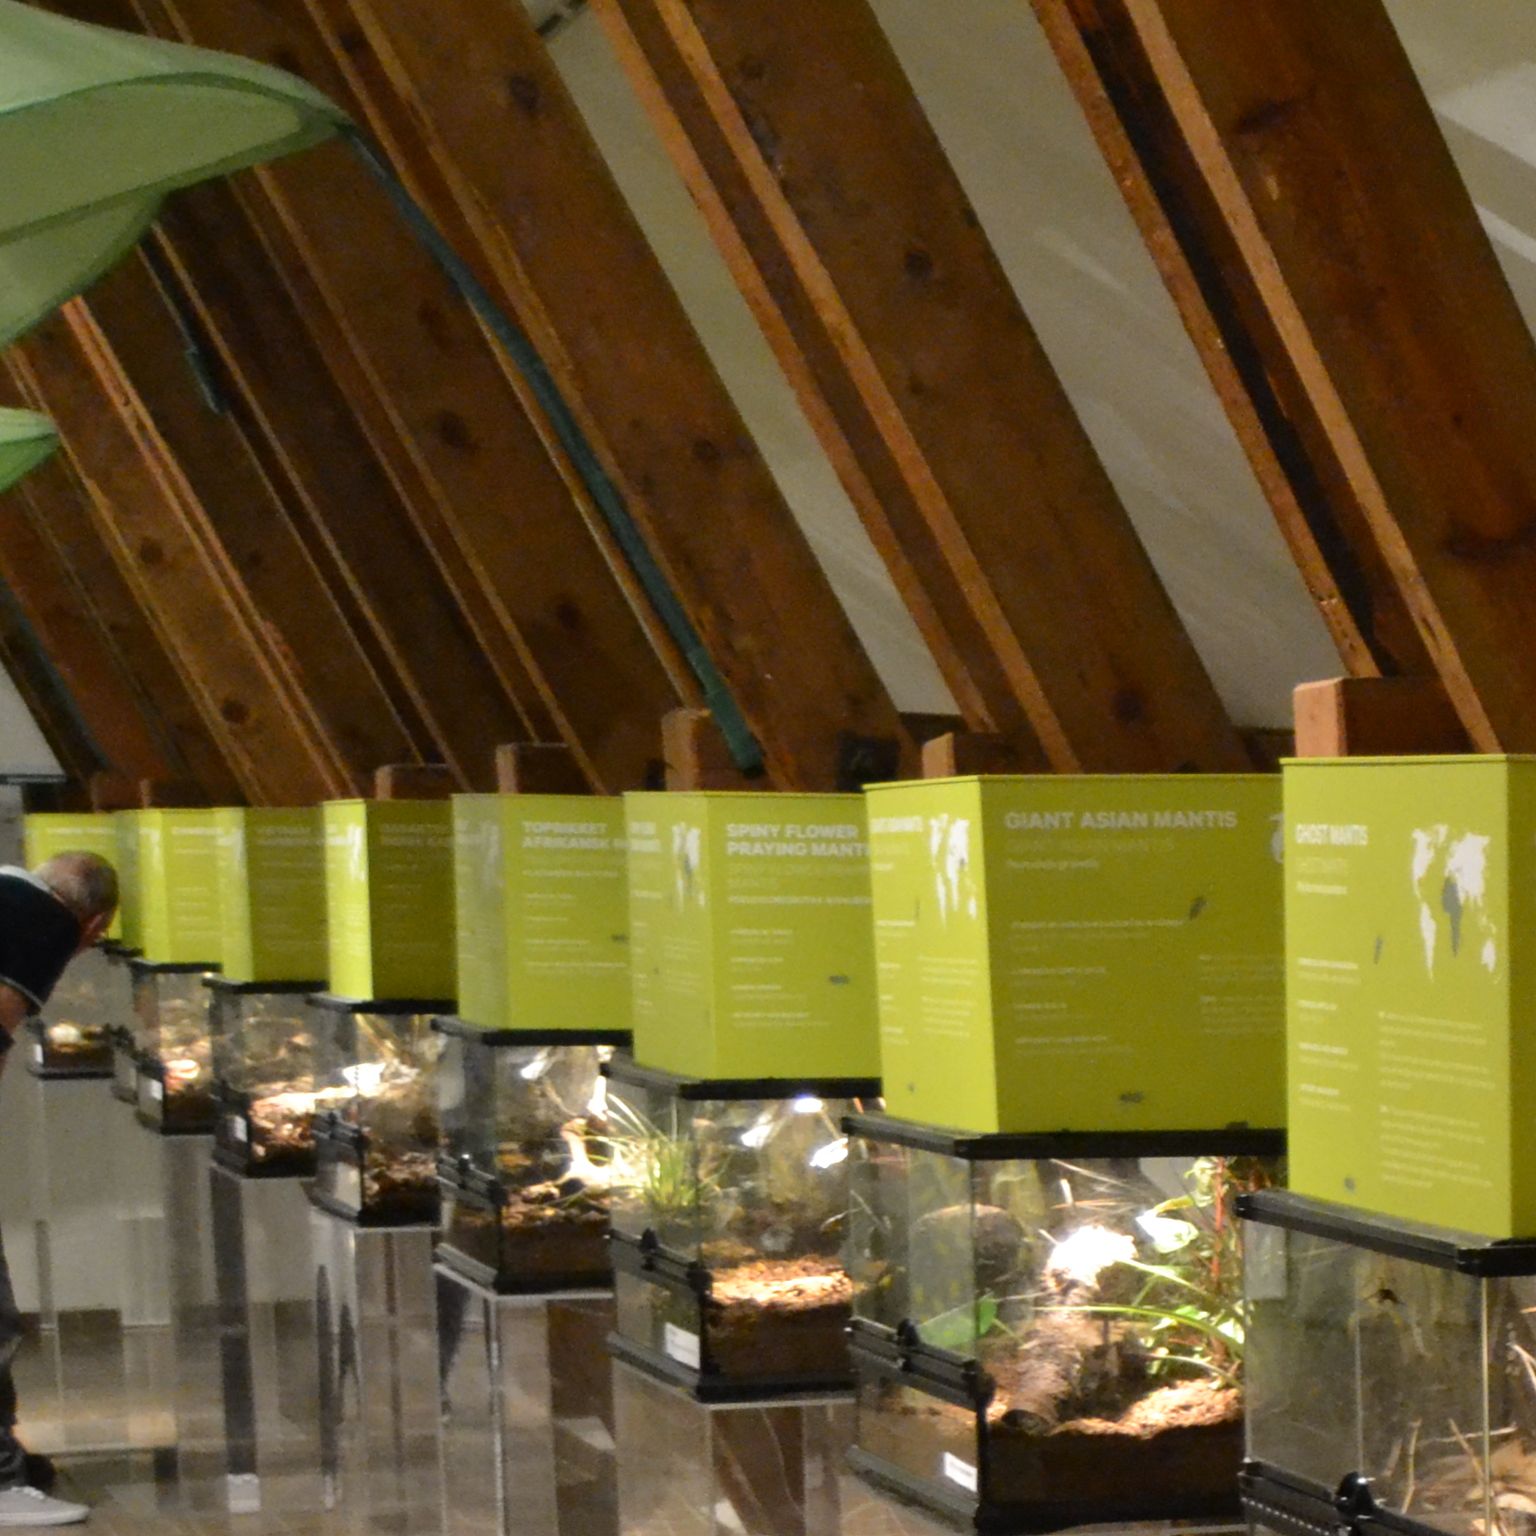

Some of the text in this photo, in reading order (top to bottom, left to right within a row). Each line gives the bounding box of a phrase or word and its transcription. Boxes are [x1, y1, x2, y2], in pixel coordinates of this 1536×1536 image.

[1004, 810, 1238, 829] GIANT ASIAN MANTIS
[785, 824, 858, 839] FLOWER
[811, 843, 869, 857] MANTI
